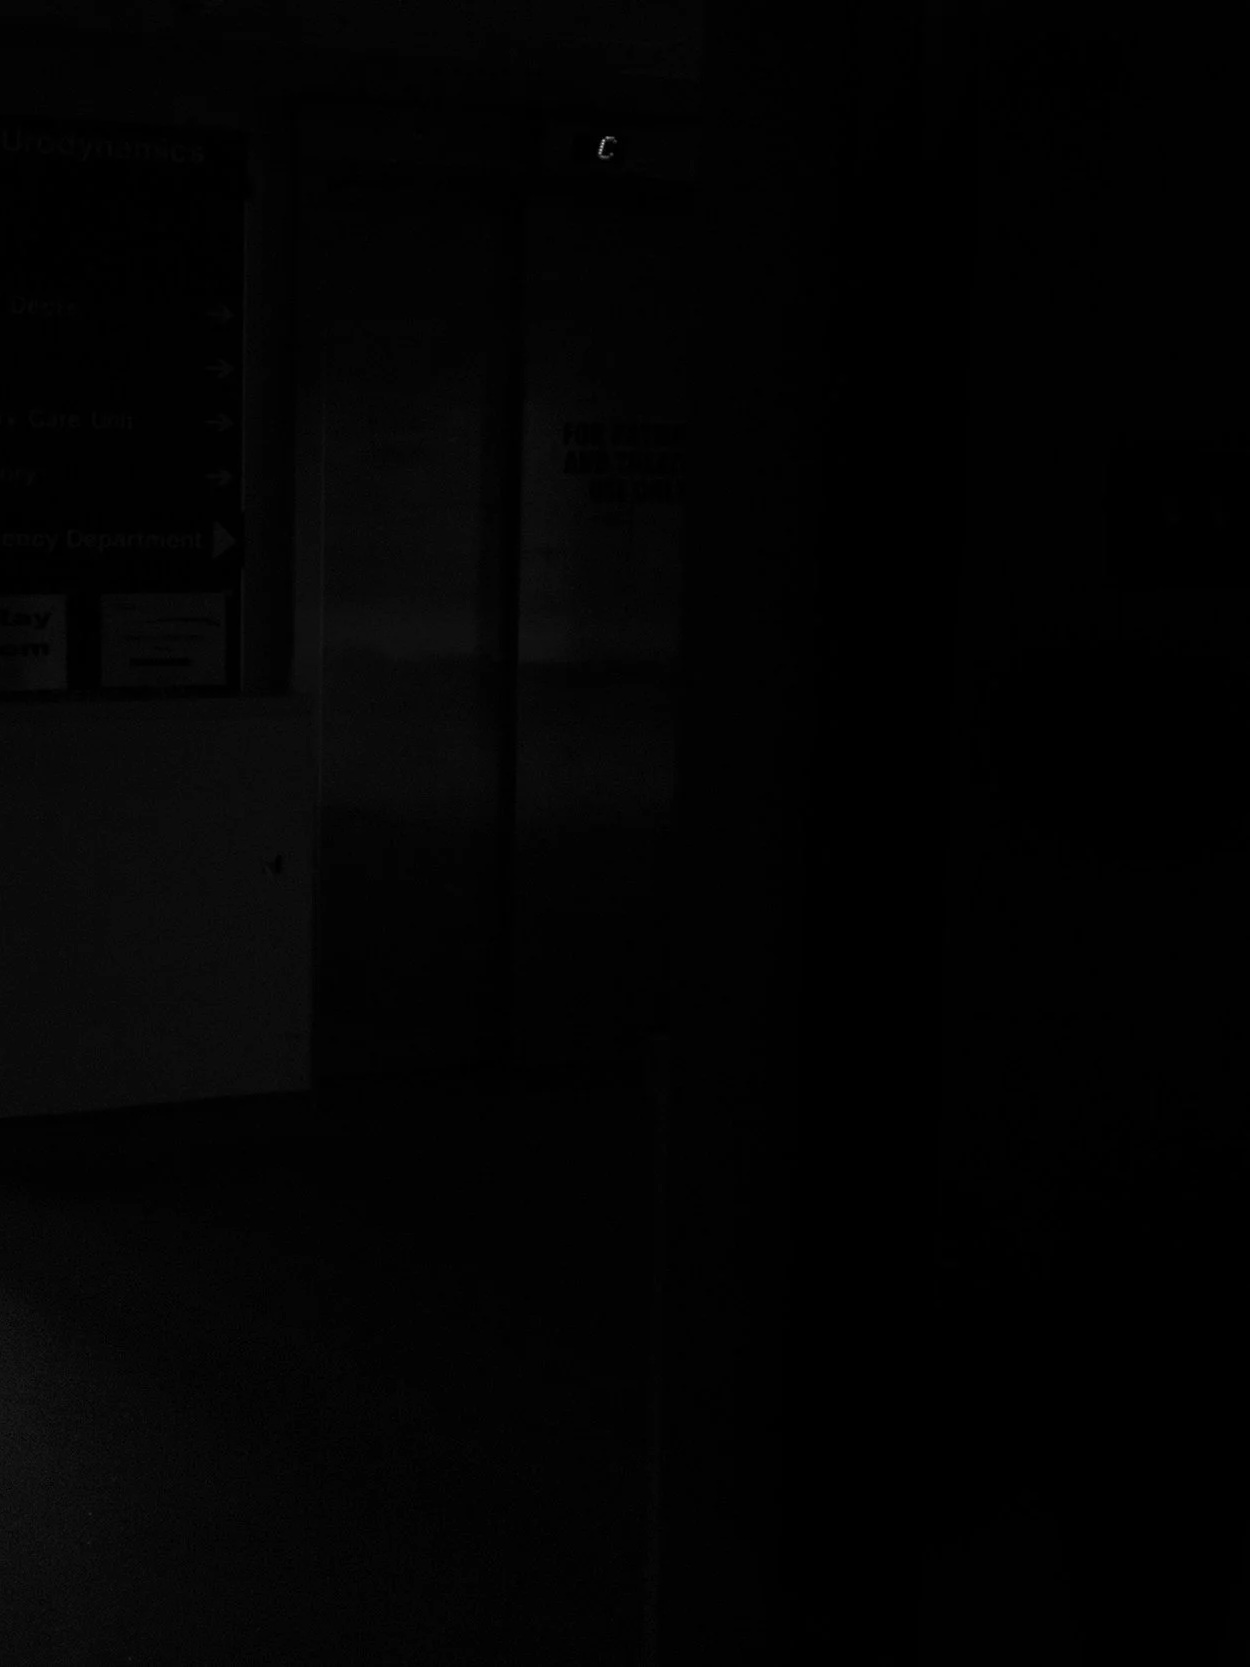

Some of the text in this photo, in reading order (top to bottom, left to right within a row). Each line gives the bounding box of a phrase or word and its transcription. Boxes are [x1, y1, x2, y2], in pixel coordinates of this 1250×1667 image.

[2, 126, 205, 164] Urodynamics
[26, 408, 81, 429] Care
[91, 410, 134, 431] Unit
[66, 529, 203, 554] Department
